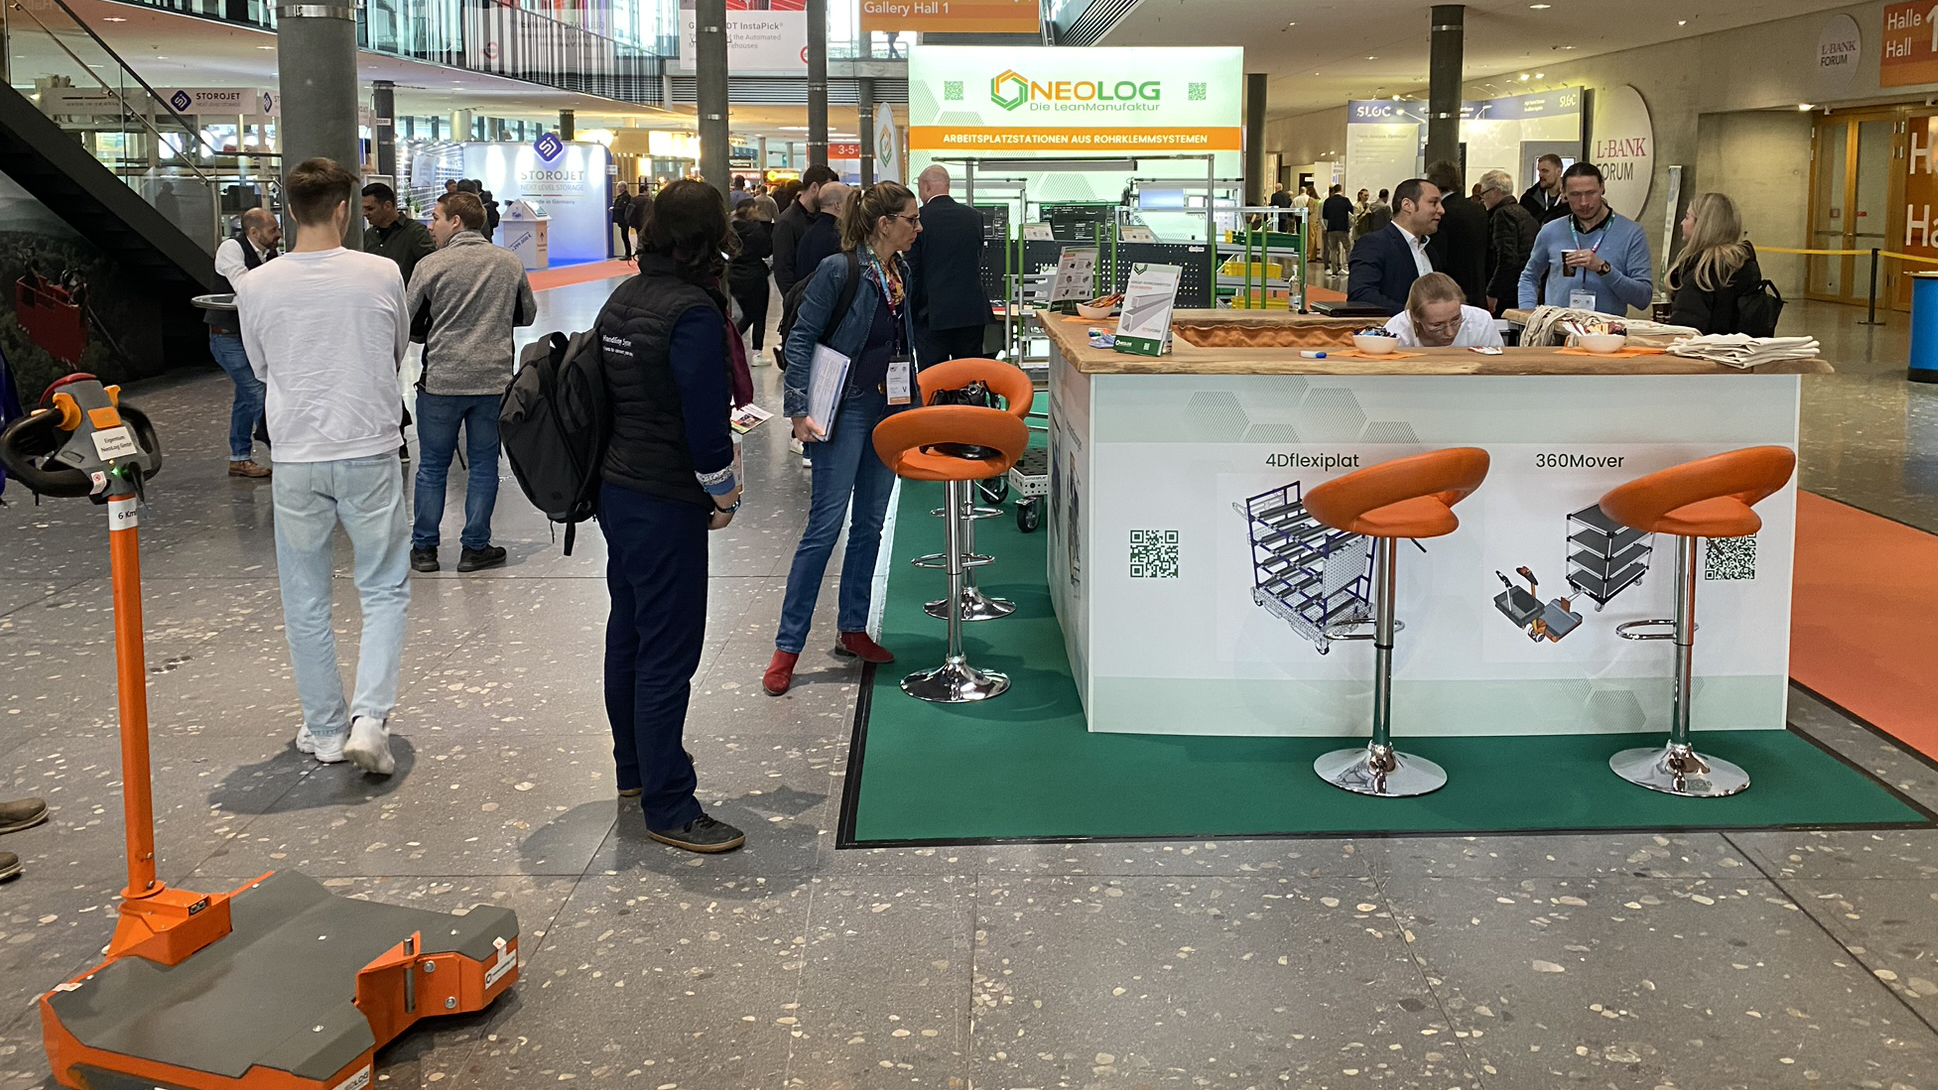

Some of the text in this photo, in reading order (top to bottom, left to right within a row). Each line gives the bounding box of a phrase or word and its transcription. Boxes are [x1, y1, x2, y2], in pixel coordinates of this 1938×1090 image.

[864, 1, 949, 17] Gallery Hall 1
[1887, 9, 1921, 31] Halle
[1886, 37, 1912, 58] Hall
[1820, 54, 1848, 67] FORUM
[195, 92, 241, 100] STOROJET
[1030, 80, 1161, 101] NEOLOG
[1030, 102, 1161, 112] Die LeanManufaktur
[943, 133, 1208, 144] ARBEITSPLATZSTATIONEN AUS ROHRKLEMMSYSTEMEN
[521, 171, 584, 180] STOROJET
[1265, 452, 1360, 472] 4Dflexiplat
[1535, 453, 1625, 468] 360Mover
[118, 511, 124, 520] 6
